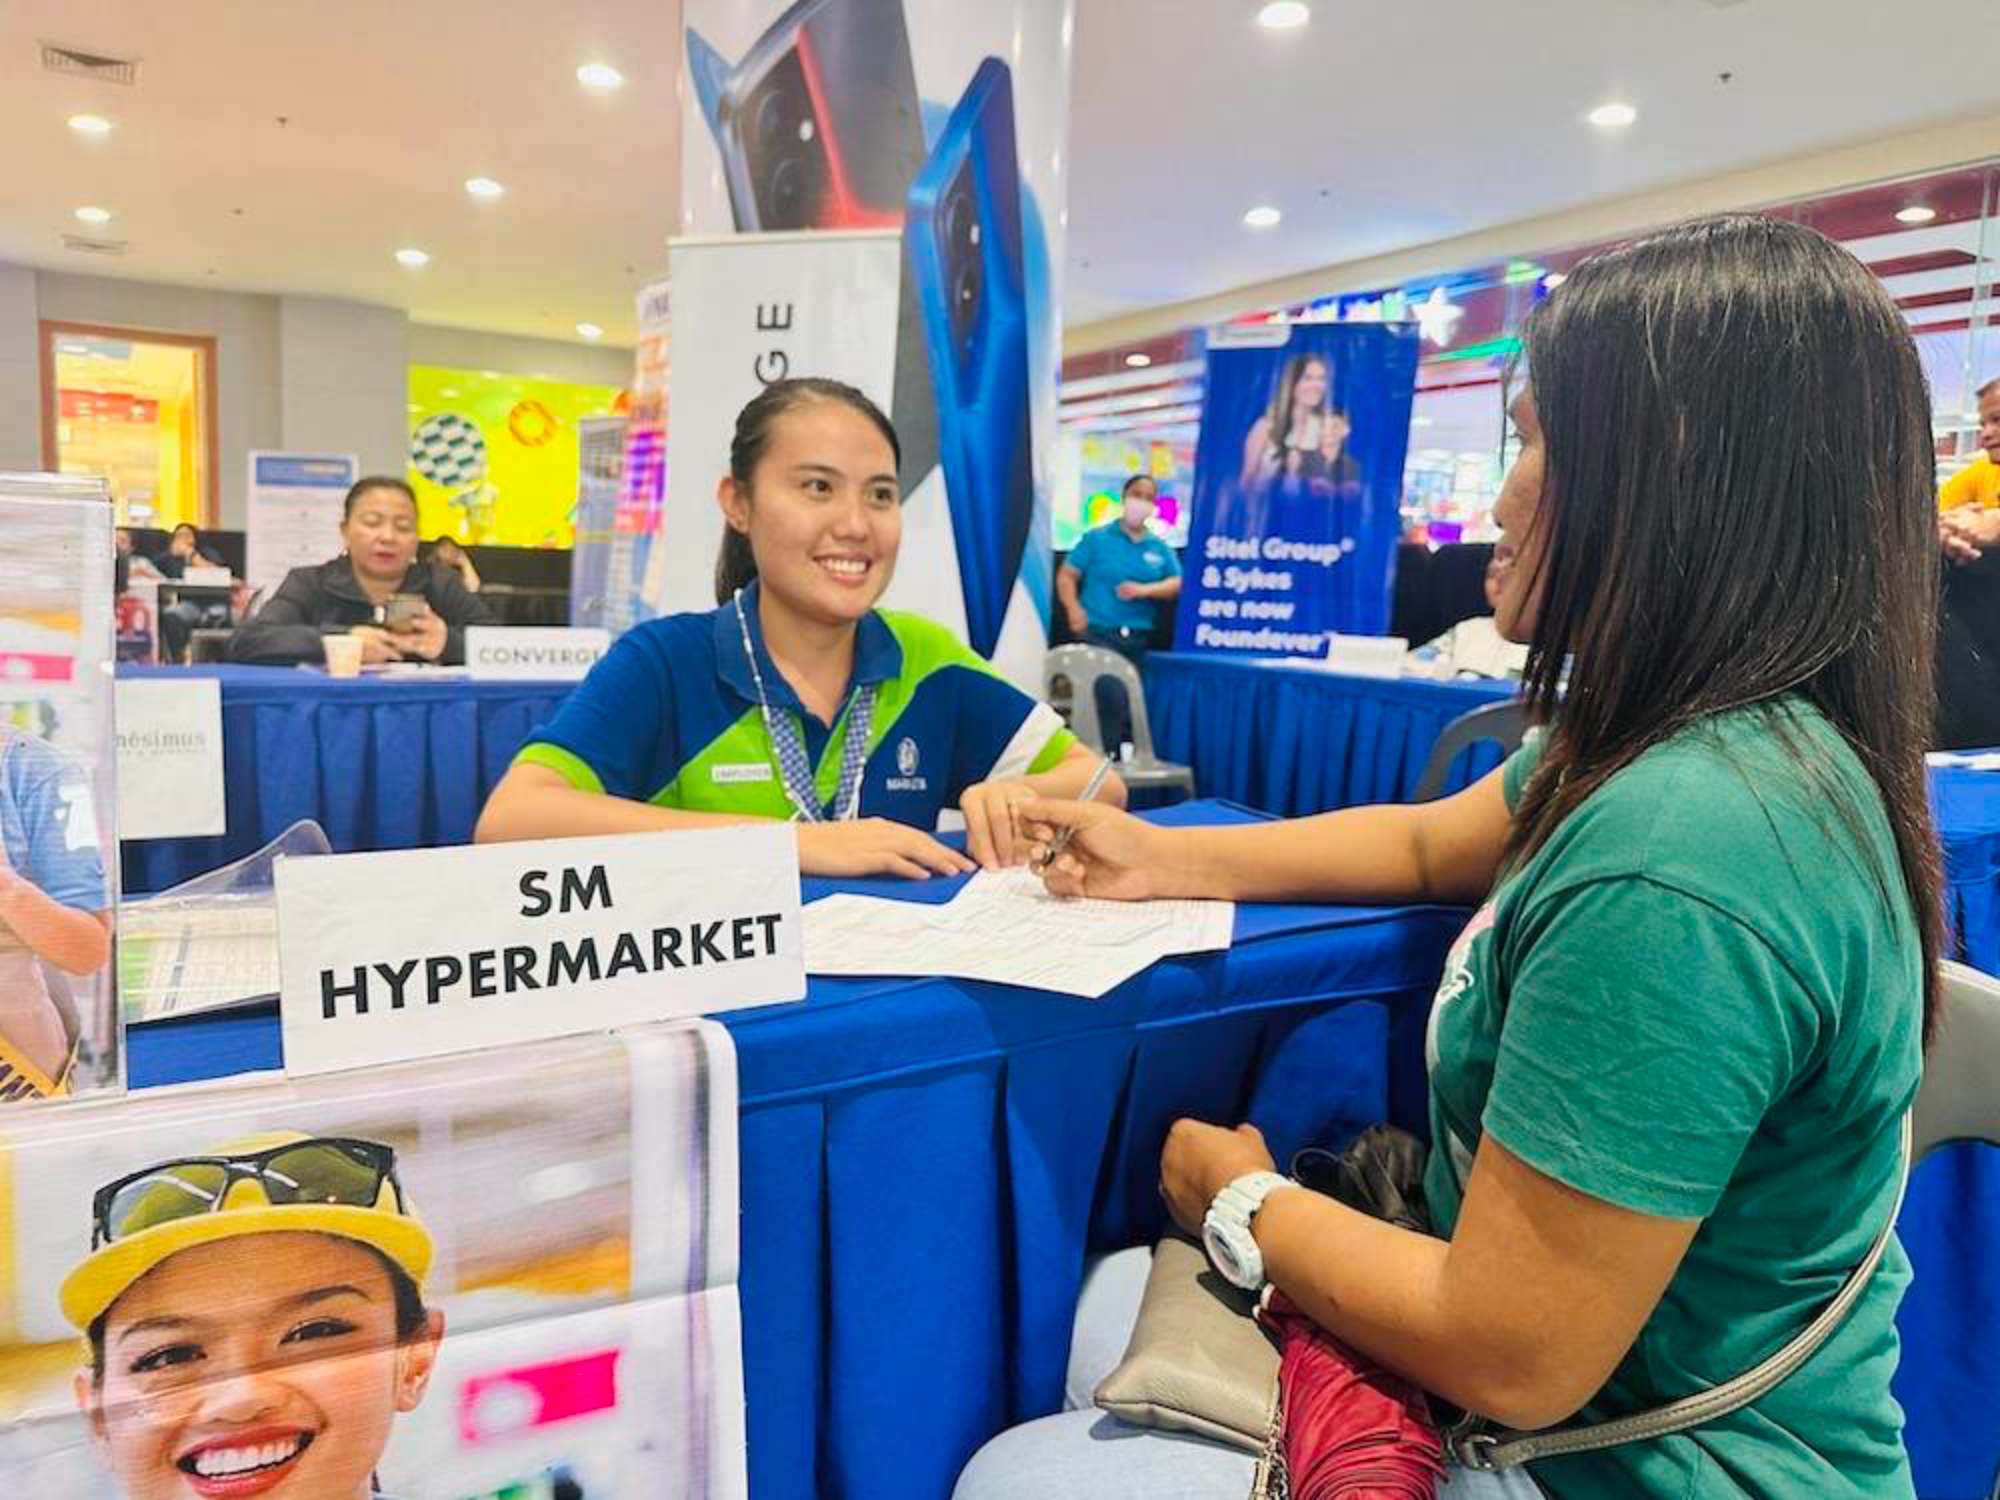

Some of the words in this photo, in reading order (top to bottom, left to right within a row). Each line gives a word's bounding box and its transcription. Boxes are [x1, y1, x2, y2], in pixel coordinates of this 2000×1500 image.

[1206, 536, 1259, 559] Sitel
[1202, 565, 1220, 588] &
[1224, 566, 1292, 594] Sykes
[1199, 600, 1237, 618] are
[1241, 602, 1294, 620] now
[519, 865, 614, 917] SM
[320, 913, 782, 1018] HYPERMARKET
